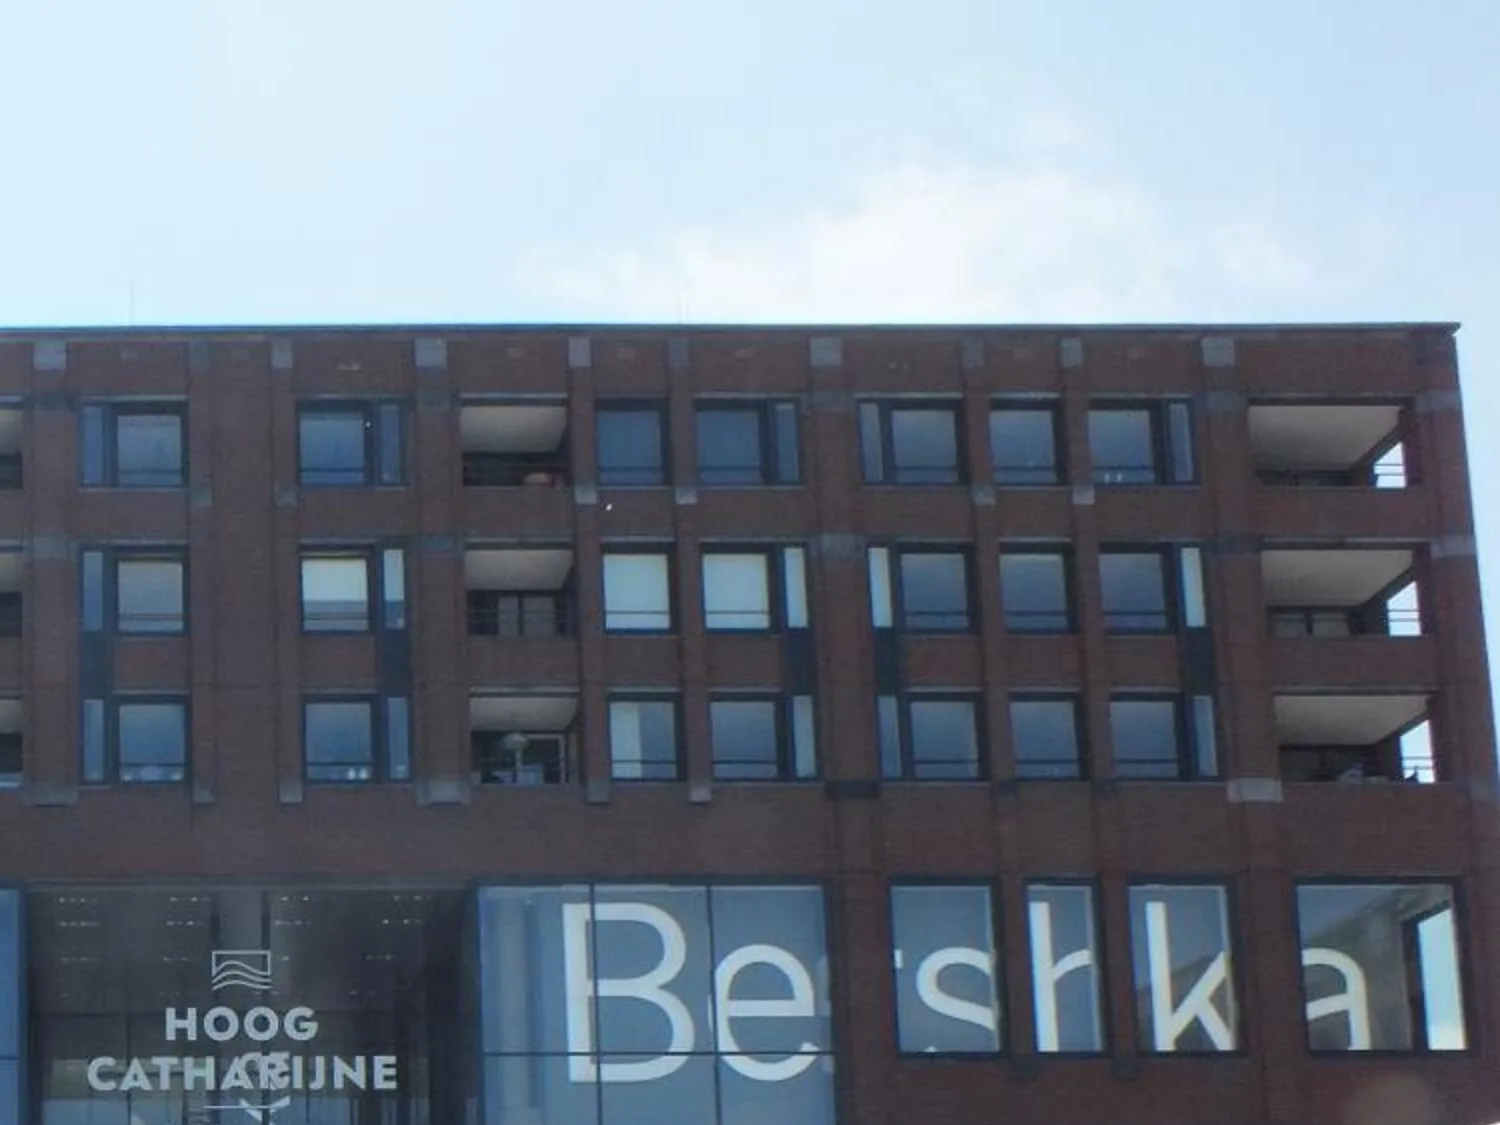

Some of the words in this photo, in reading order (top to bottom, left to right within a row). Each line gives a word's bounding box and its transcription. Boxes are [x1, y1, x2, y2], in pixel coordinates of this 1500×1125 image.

[562, 902, 1367, 1084] Beshka
[164, 1005, 319, 1042] HOOG
[86, 1054, 398, 1092] CATHARIJNE
